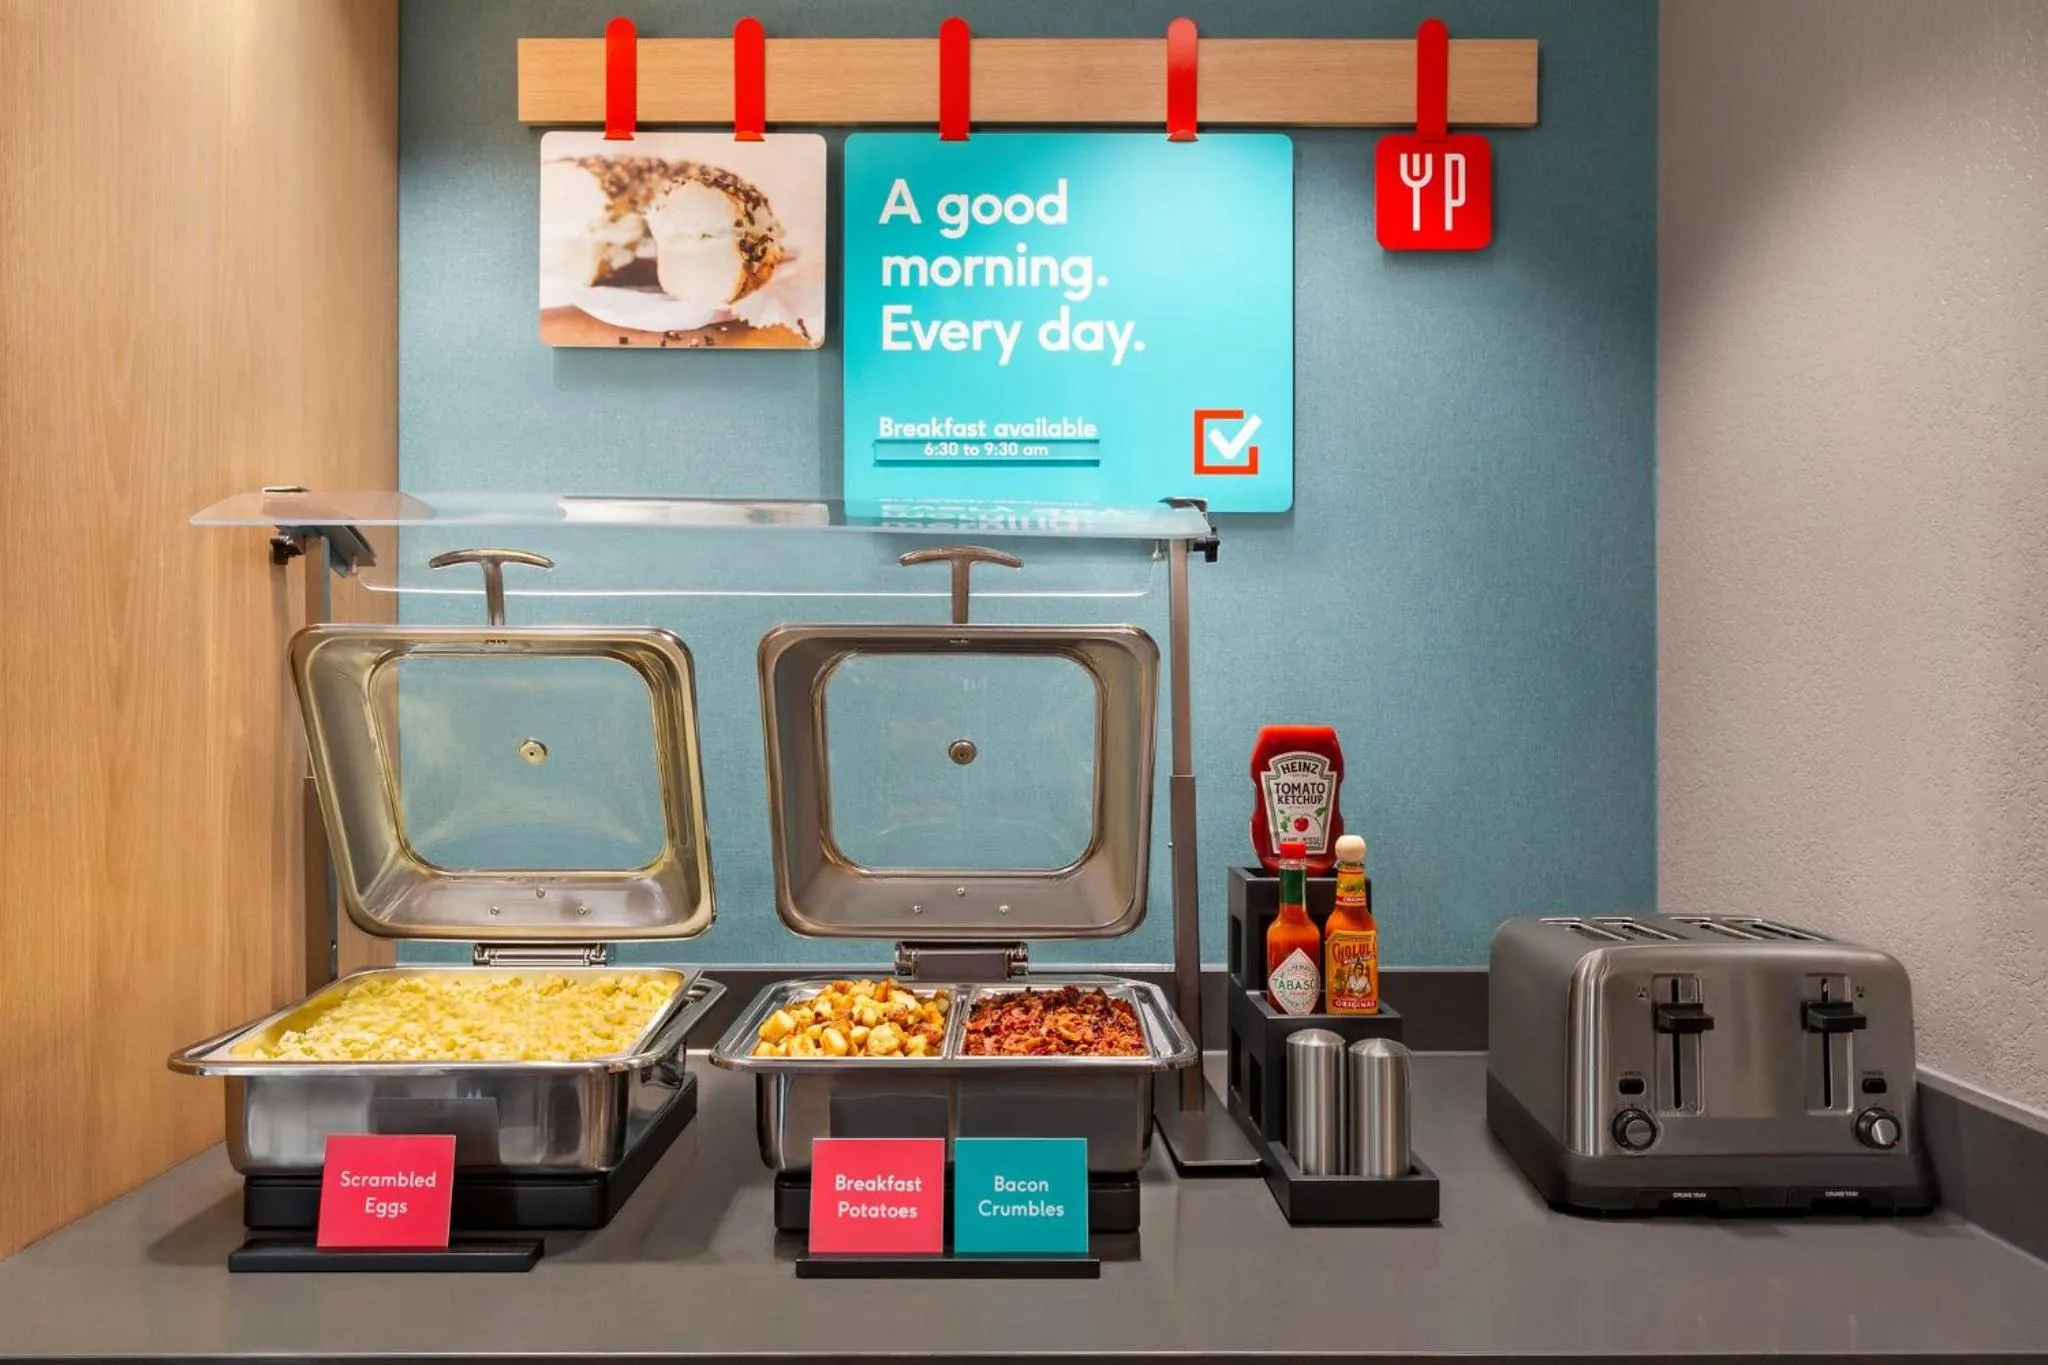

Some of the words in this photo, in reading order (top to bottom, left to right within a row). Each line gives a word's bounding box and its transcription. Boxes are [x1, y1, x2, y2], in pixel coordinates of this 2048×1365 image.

[878, 178, 922, 225] A
[936, 178, 1069, 240] good
[881, 242, 1110, 301] morning.
[881, 304, 1024, 367] Every
[1037, 304, 1147, 367] day.
[879, 416, 987, 438] Breakfast
[993, 416, 1098, 438] available
[923, 442, 959, 457] 6:30
[963, 442, 980, 457] to
[984, 442, 1019, 457] 9:30
[1023, 444, 1049, 457] am
[1280, 761, 1320, 775] HEINZ
[1273, 782, 1326, 795] TOMATO
[1277, 795, 1325, 805] KETCHUP
[339, 1170, 437, 1189] Scrambled
[834, 1174, 923, 1192] Breakfast
[993, 1175, 1049, 1192] Bacon
[364, 1196, 408, 1219] Eggs
[837, 1200, 918, 1218] Potatoes
[978, 1199, 1065, 1218] Crumbles
